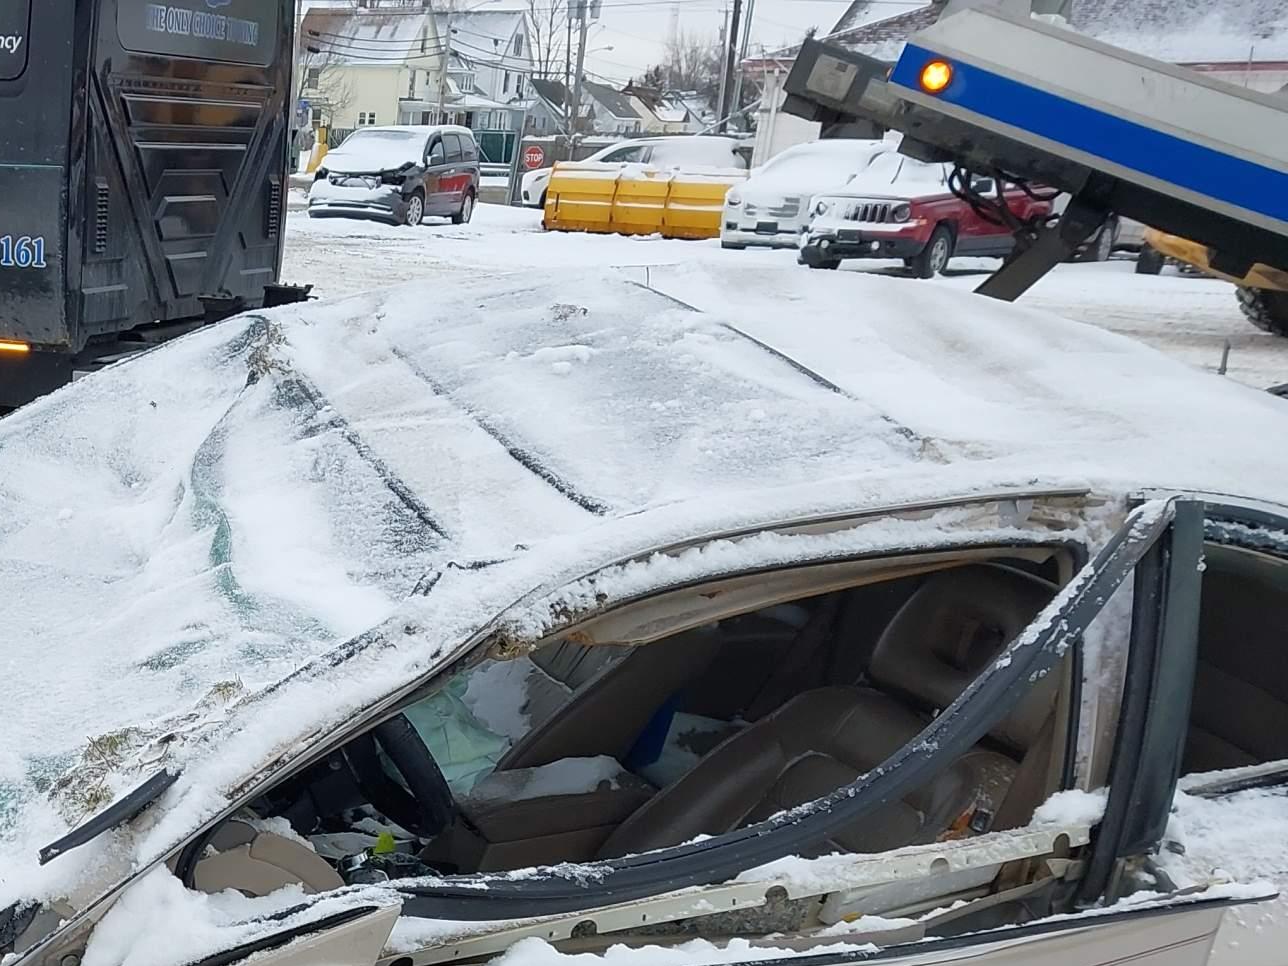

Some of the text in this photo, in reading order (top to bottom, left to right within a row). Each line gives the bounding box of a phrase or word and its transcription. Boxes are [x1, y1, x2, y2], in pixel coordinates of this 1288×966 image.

[145, 4, 165, 31] THE
[166, 7, 192, 35] ONLY
[192, 11, 226, 40] CHOICE
[525, 153, 543, 162] STOP
